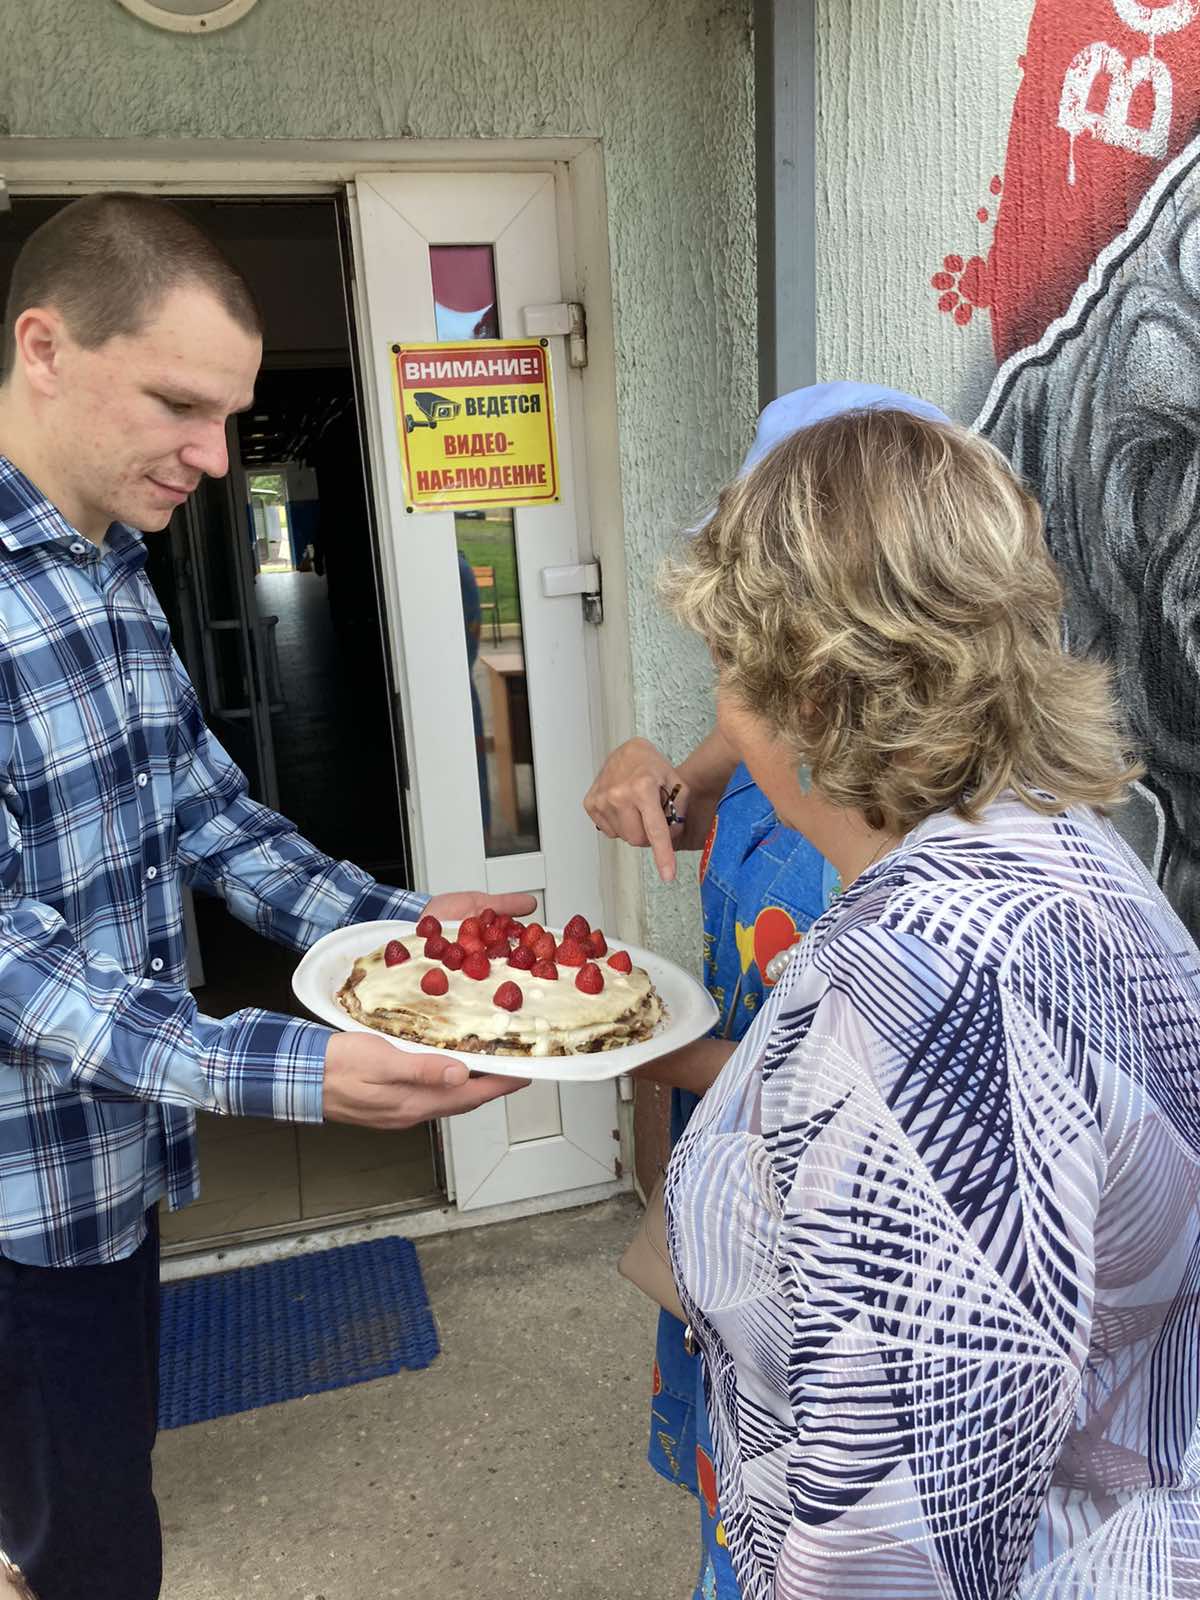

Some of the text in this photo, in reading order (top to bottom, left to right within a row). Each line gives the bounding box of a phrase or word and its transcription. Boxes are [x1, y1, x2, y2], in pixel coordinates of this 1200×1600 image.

[405, 357, 539, 380] ВНИМАНИЕ!
[465, 394, 541, 418] ВЕДЕТСЯ
[443, 432, 514, 456] ВИДЕО-
[416, 464, 547, 491] НАБЛЮДЕНИЕ
